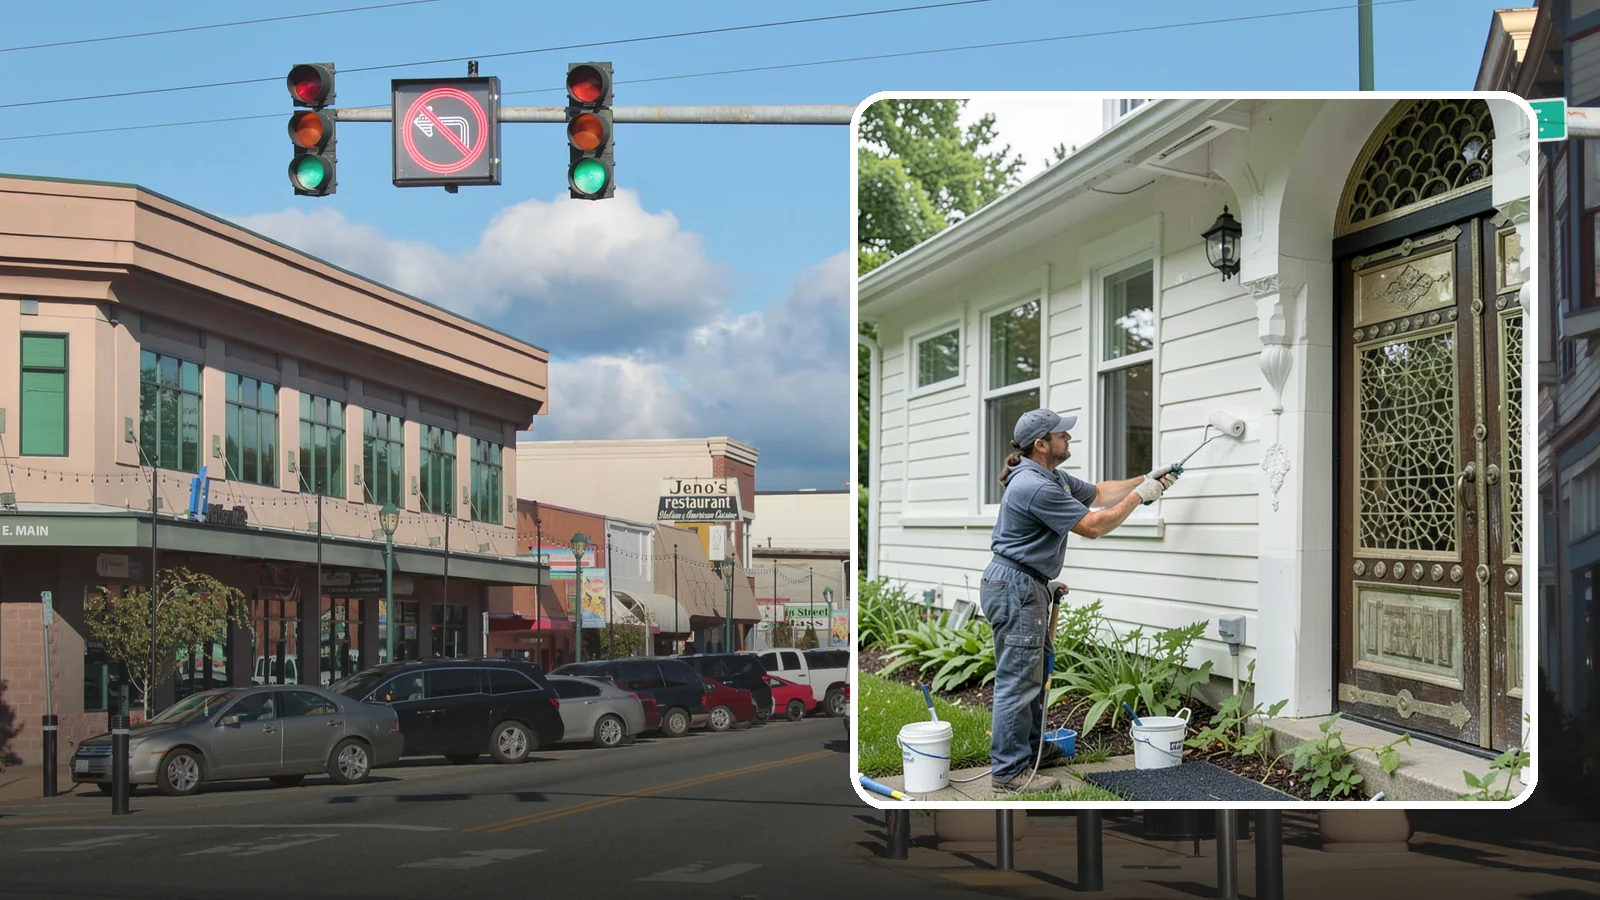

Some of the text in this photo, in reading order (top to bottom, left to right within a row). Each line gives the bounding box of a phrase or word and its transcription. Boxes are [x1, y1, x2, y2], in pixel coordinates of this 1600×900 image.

[669, 480, 727, 495] Jeno's
[665, 496, 731, 509] restaurant
[658, 509, 682, 520] Italian
[686, 509, 714, 519] American
[715, 509, 737, 520] Cuisine
[2, 525, 49, 536] E. MAIN
[797, 608, 828, 617] Street
